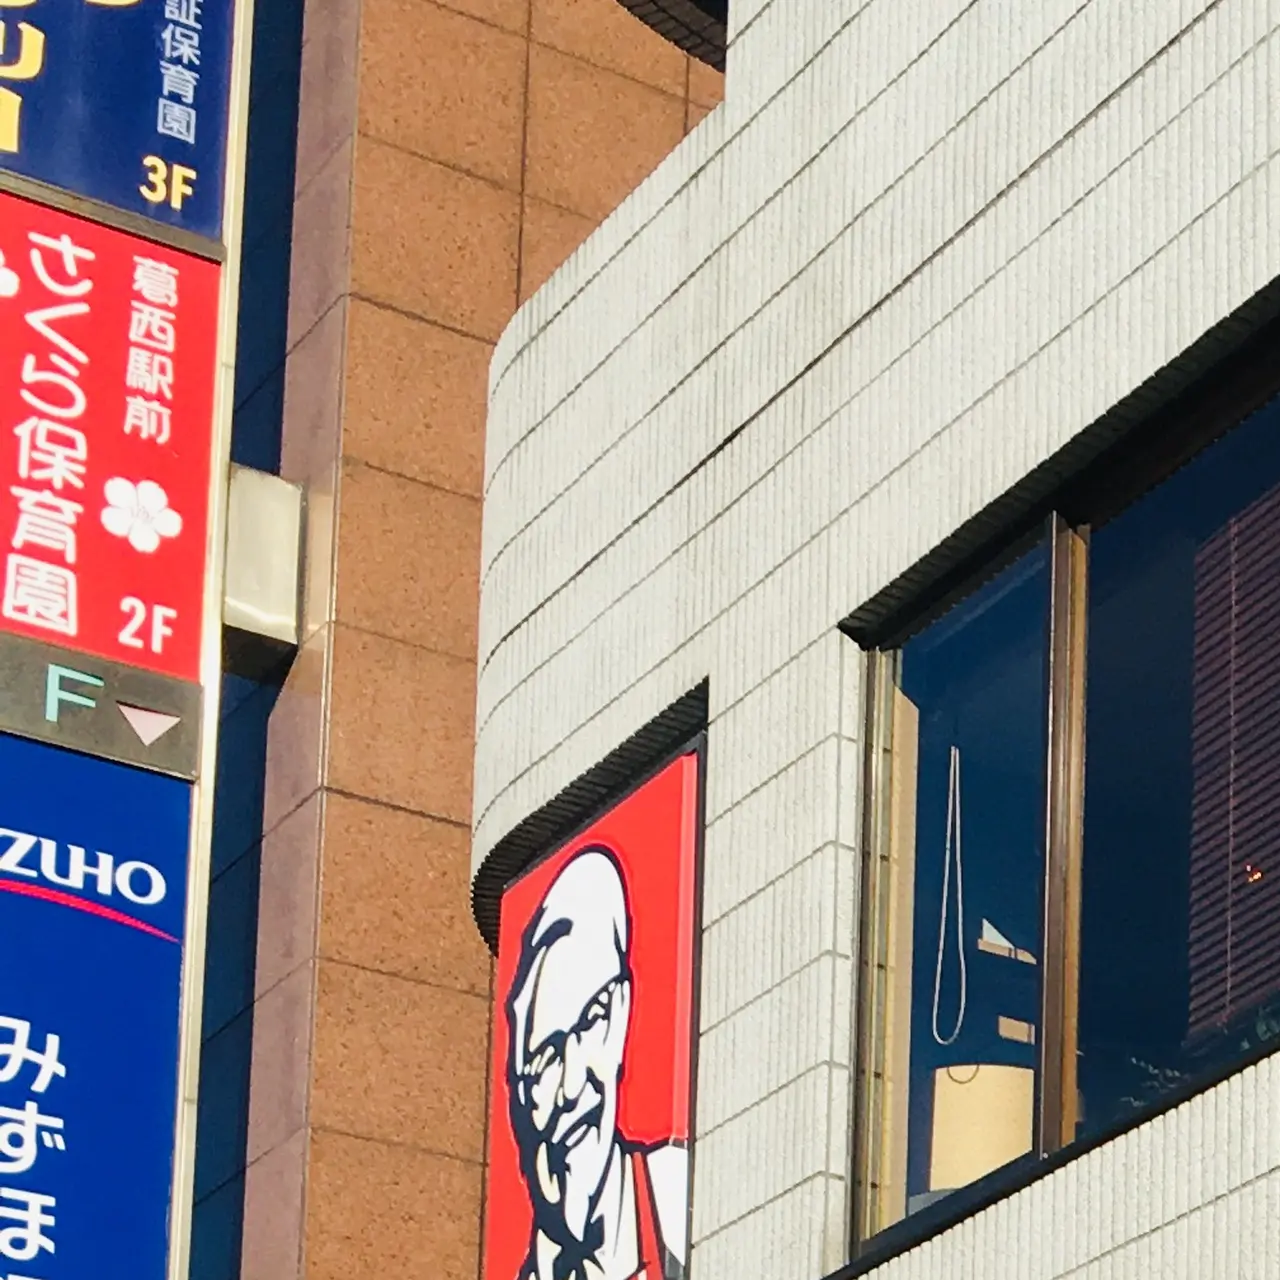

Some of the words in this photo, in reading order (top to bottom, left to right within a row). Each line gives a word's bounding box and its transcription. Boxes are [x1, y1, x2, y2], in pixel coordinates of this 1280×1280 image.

[139, 154, 197, 211] 3F
[123, 254, 179, 444] 葛西駅前
[2, 231, 96, 637] さくら保育園
[118, 595, 178, 654] 2F
